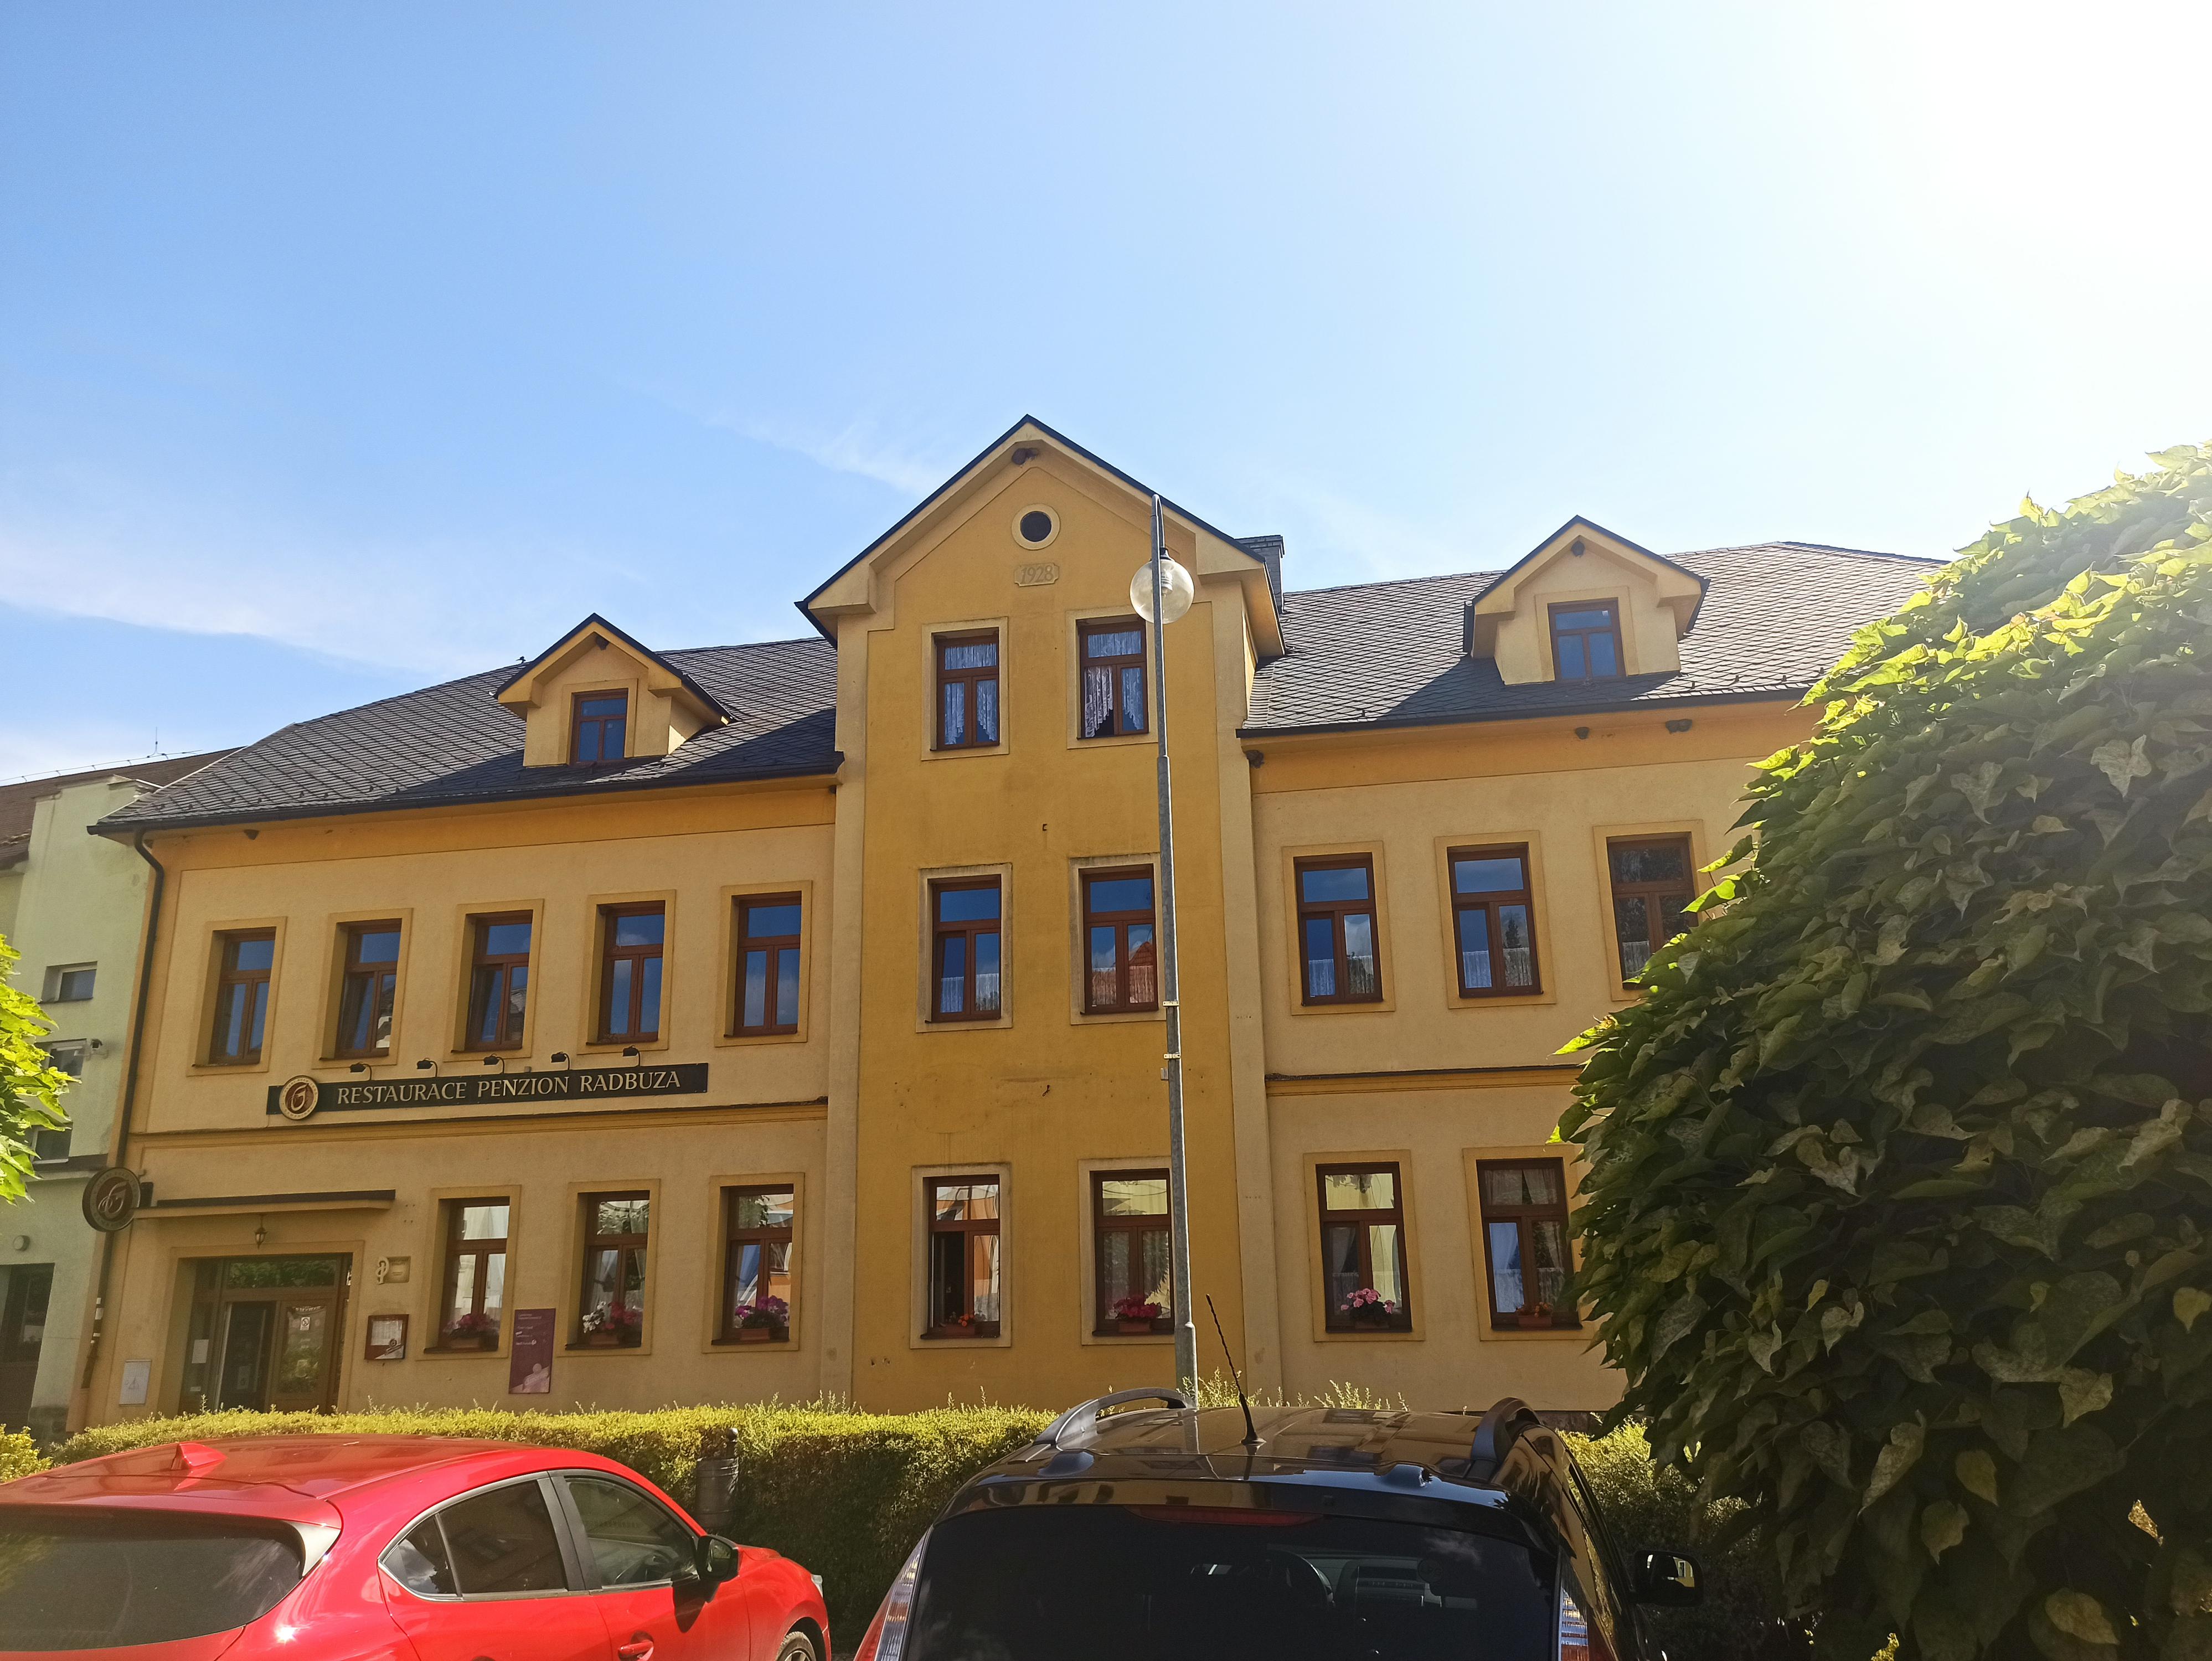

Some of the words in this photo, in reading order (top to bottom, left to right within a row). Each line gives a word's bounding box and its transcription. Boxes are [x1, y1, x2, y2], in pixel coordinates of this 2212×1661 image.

[1020, 565, 1054, 585] 1928
[337, 1082, 467, 1105] RESTAURACE
[477, 1076, 570, 1098] PENZION
[580, 1071, 682, 1092] RADBUZA
